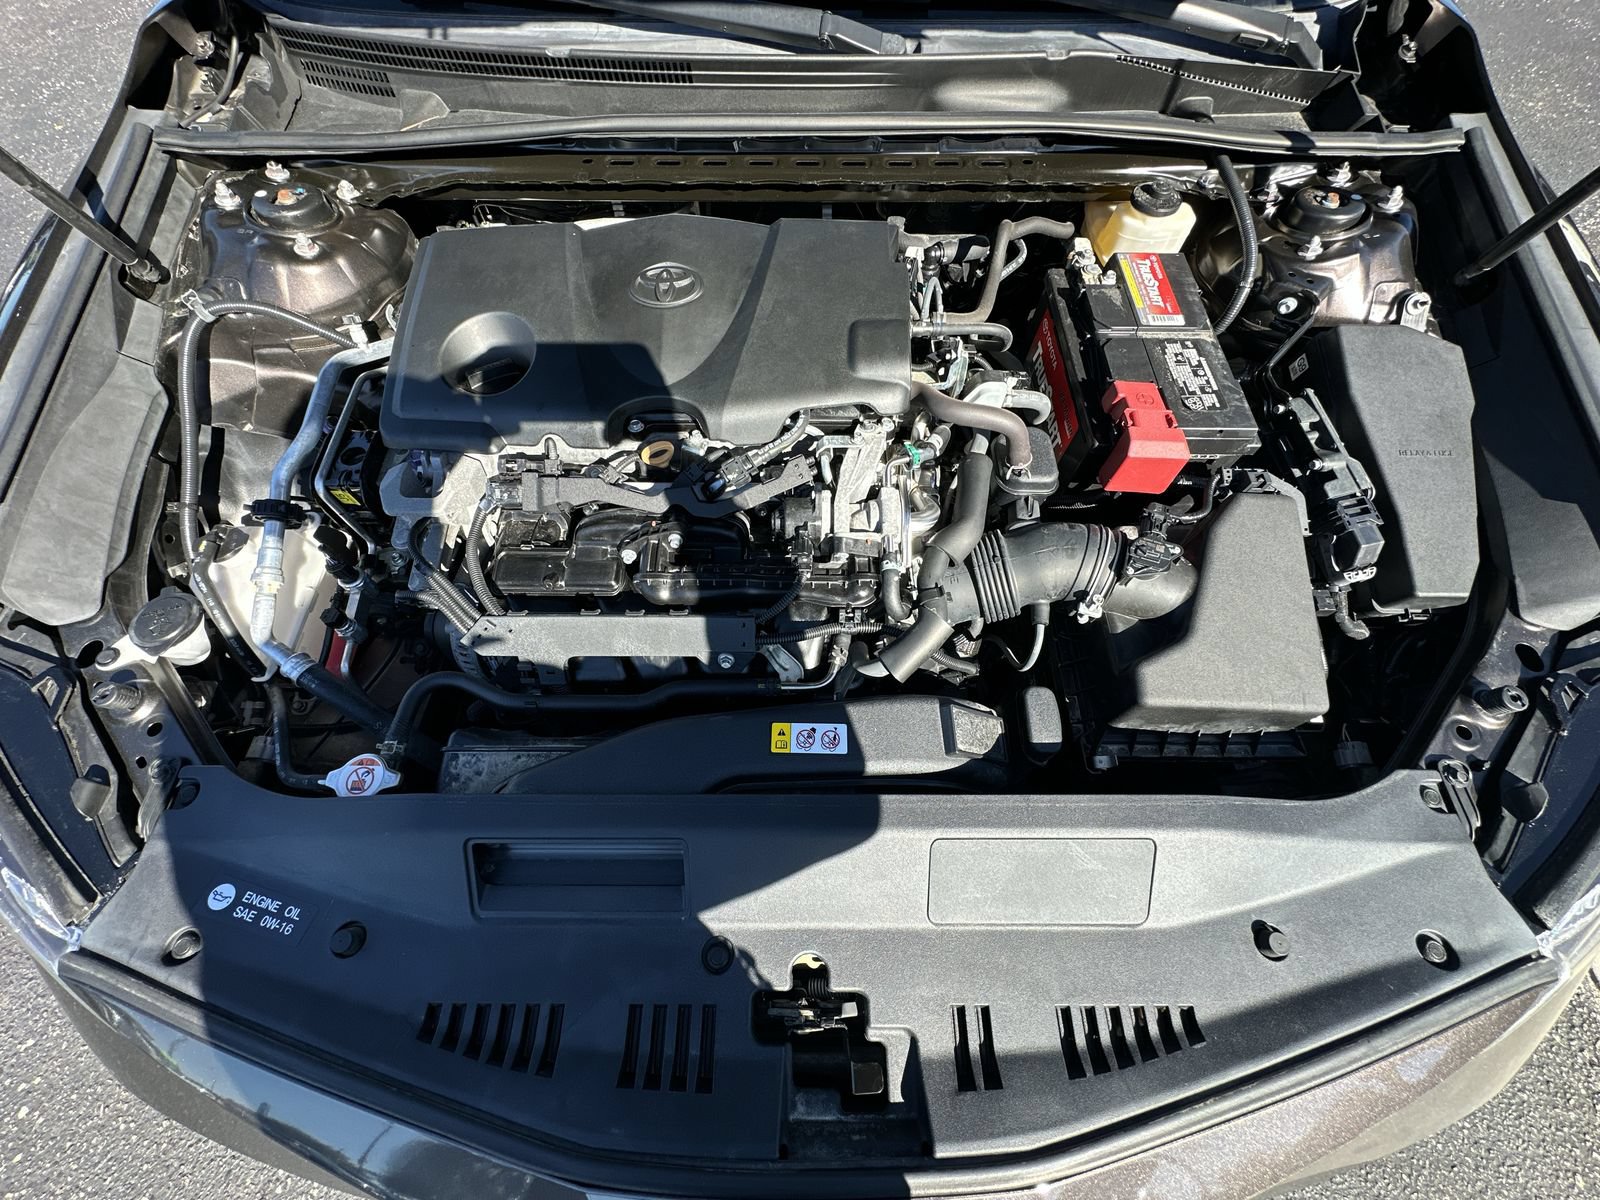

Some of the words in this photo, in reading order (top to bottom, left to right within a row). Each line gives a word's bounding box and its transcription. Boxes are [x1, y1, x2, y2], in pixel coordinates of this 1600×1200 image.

[1045, 331, 1058, 370] TOYOTA
[233, 906, 258, 922] SAE
[260, 915, 295, 935] 0W-16
[242, 891, 282, 913] ENGINE
[284, 905, 301, 921] OIL
